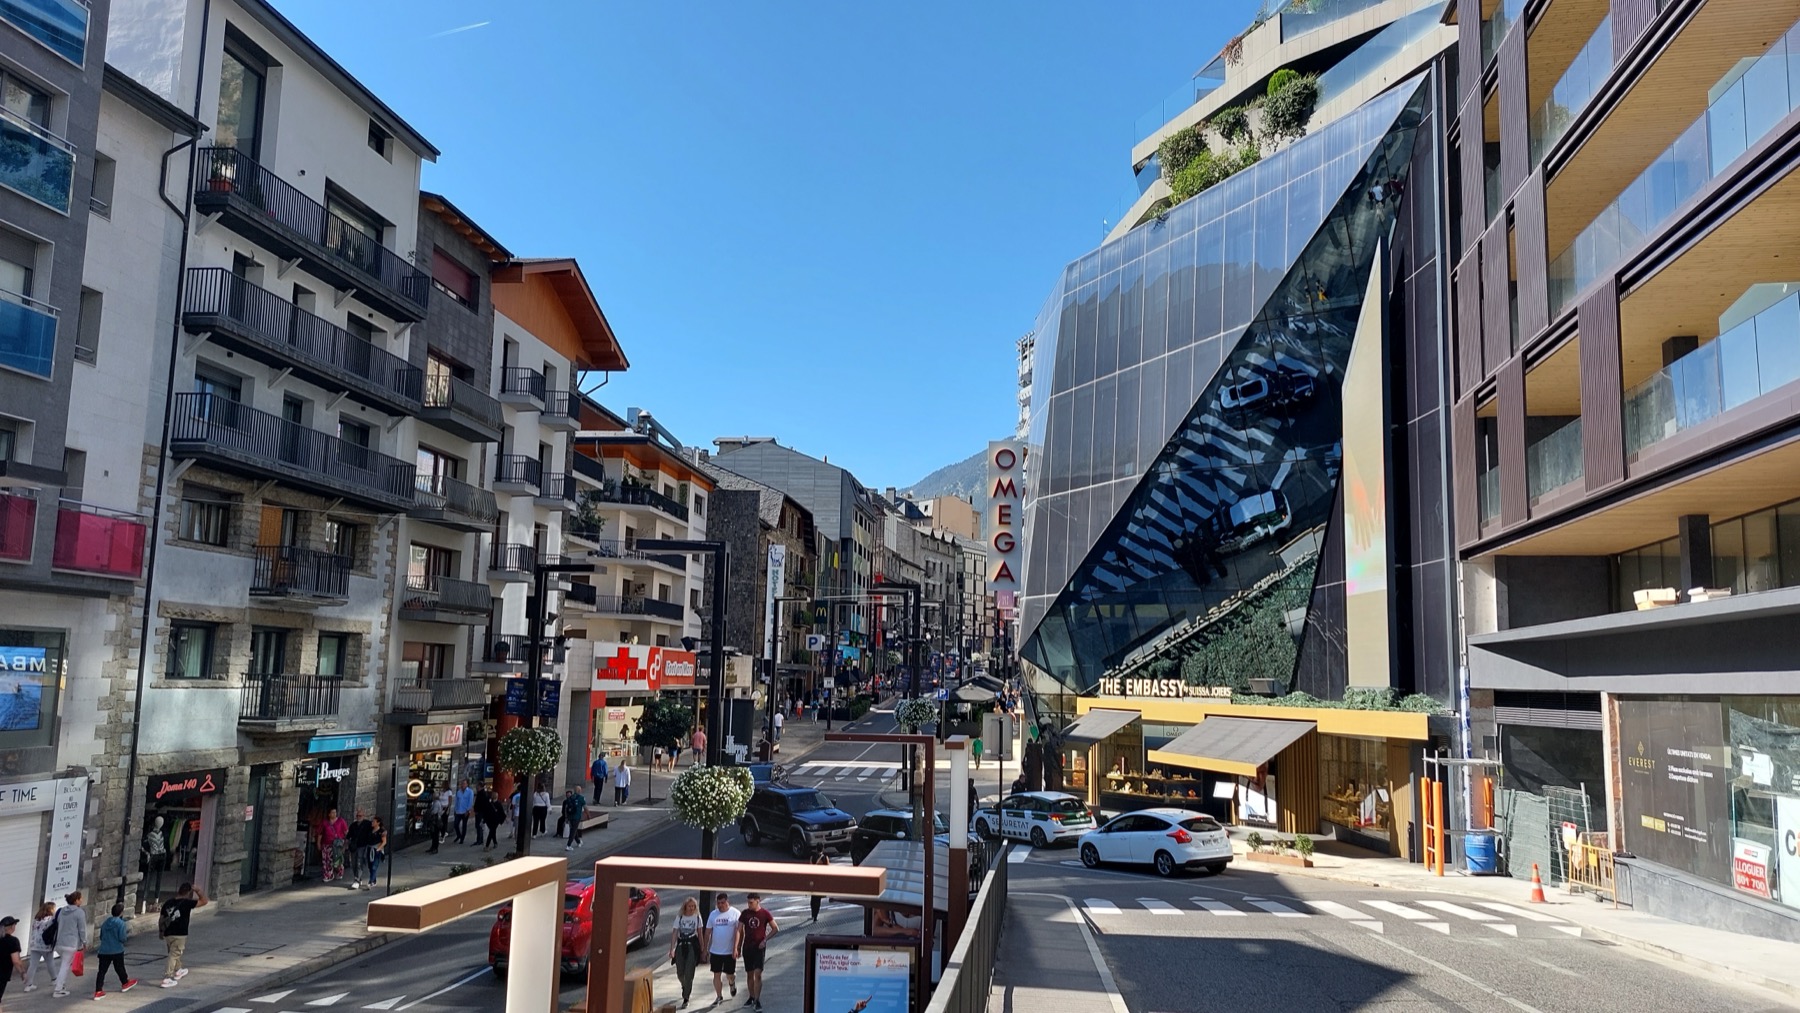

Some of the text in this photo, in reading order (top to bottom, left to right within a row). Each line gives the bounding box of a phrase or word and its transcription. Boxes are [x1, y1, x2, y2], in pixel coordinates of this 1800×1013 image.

[992, 447, 1018, 583] OMEGA
[808, 636, 819, 650] P
[939, 689, 946, 698] P
[1099, 678, 1121, 695] THE
[1125, 678, 1186, 697] EMBASSY
[1188, 686, 1210, 696] SUISSA
[1211, 686, 1233, 697] JOIERS
[415, 725, 462, 749] Foto LED
[1628, 756, 1656, 769] EVEREST
[319, 761, 350, 783] Bruges
[12, 787, 38, 803] TIME
[63, 801, 78, 810] COVER
[1735, 858, 1765, 878] LLOGUER
[52, 881, 71, 889] EDOX
[1750, 878, 1766, 892] 700
